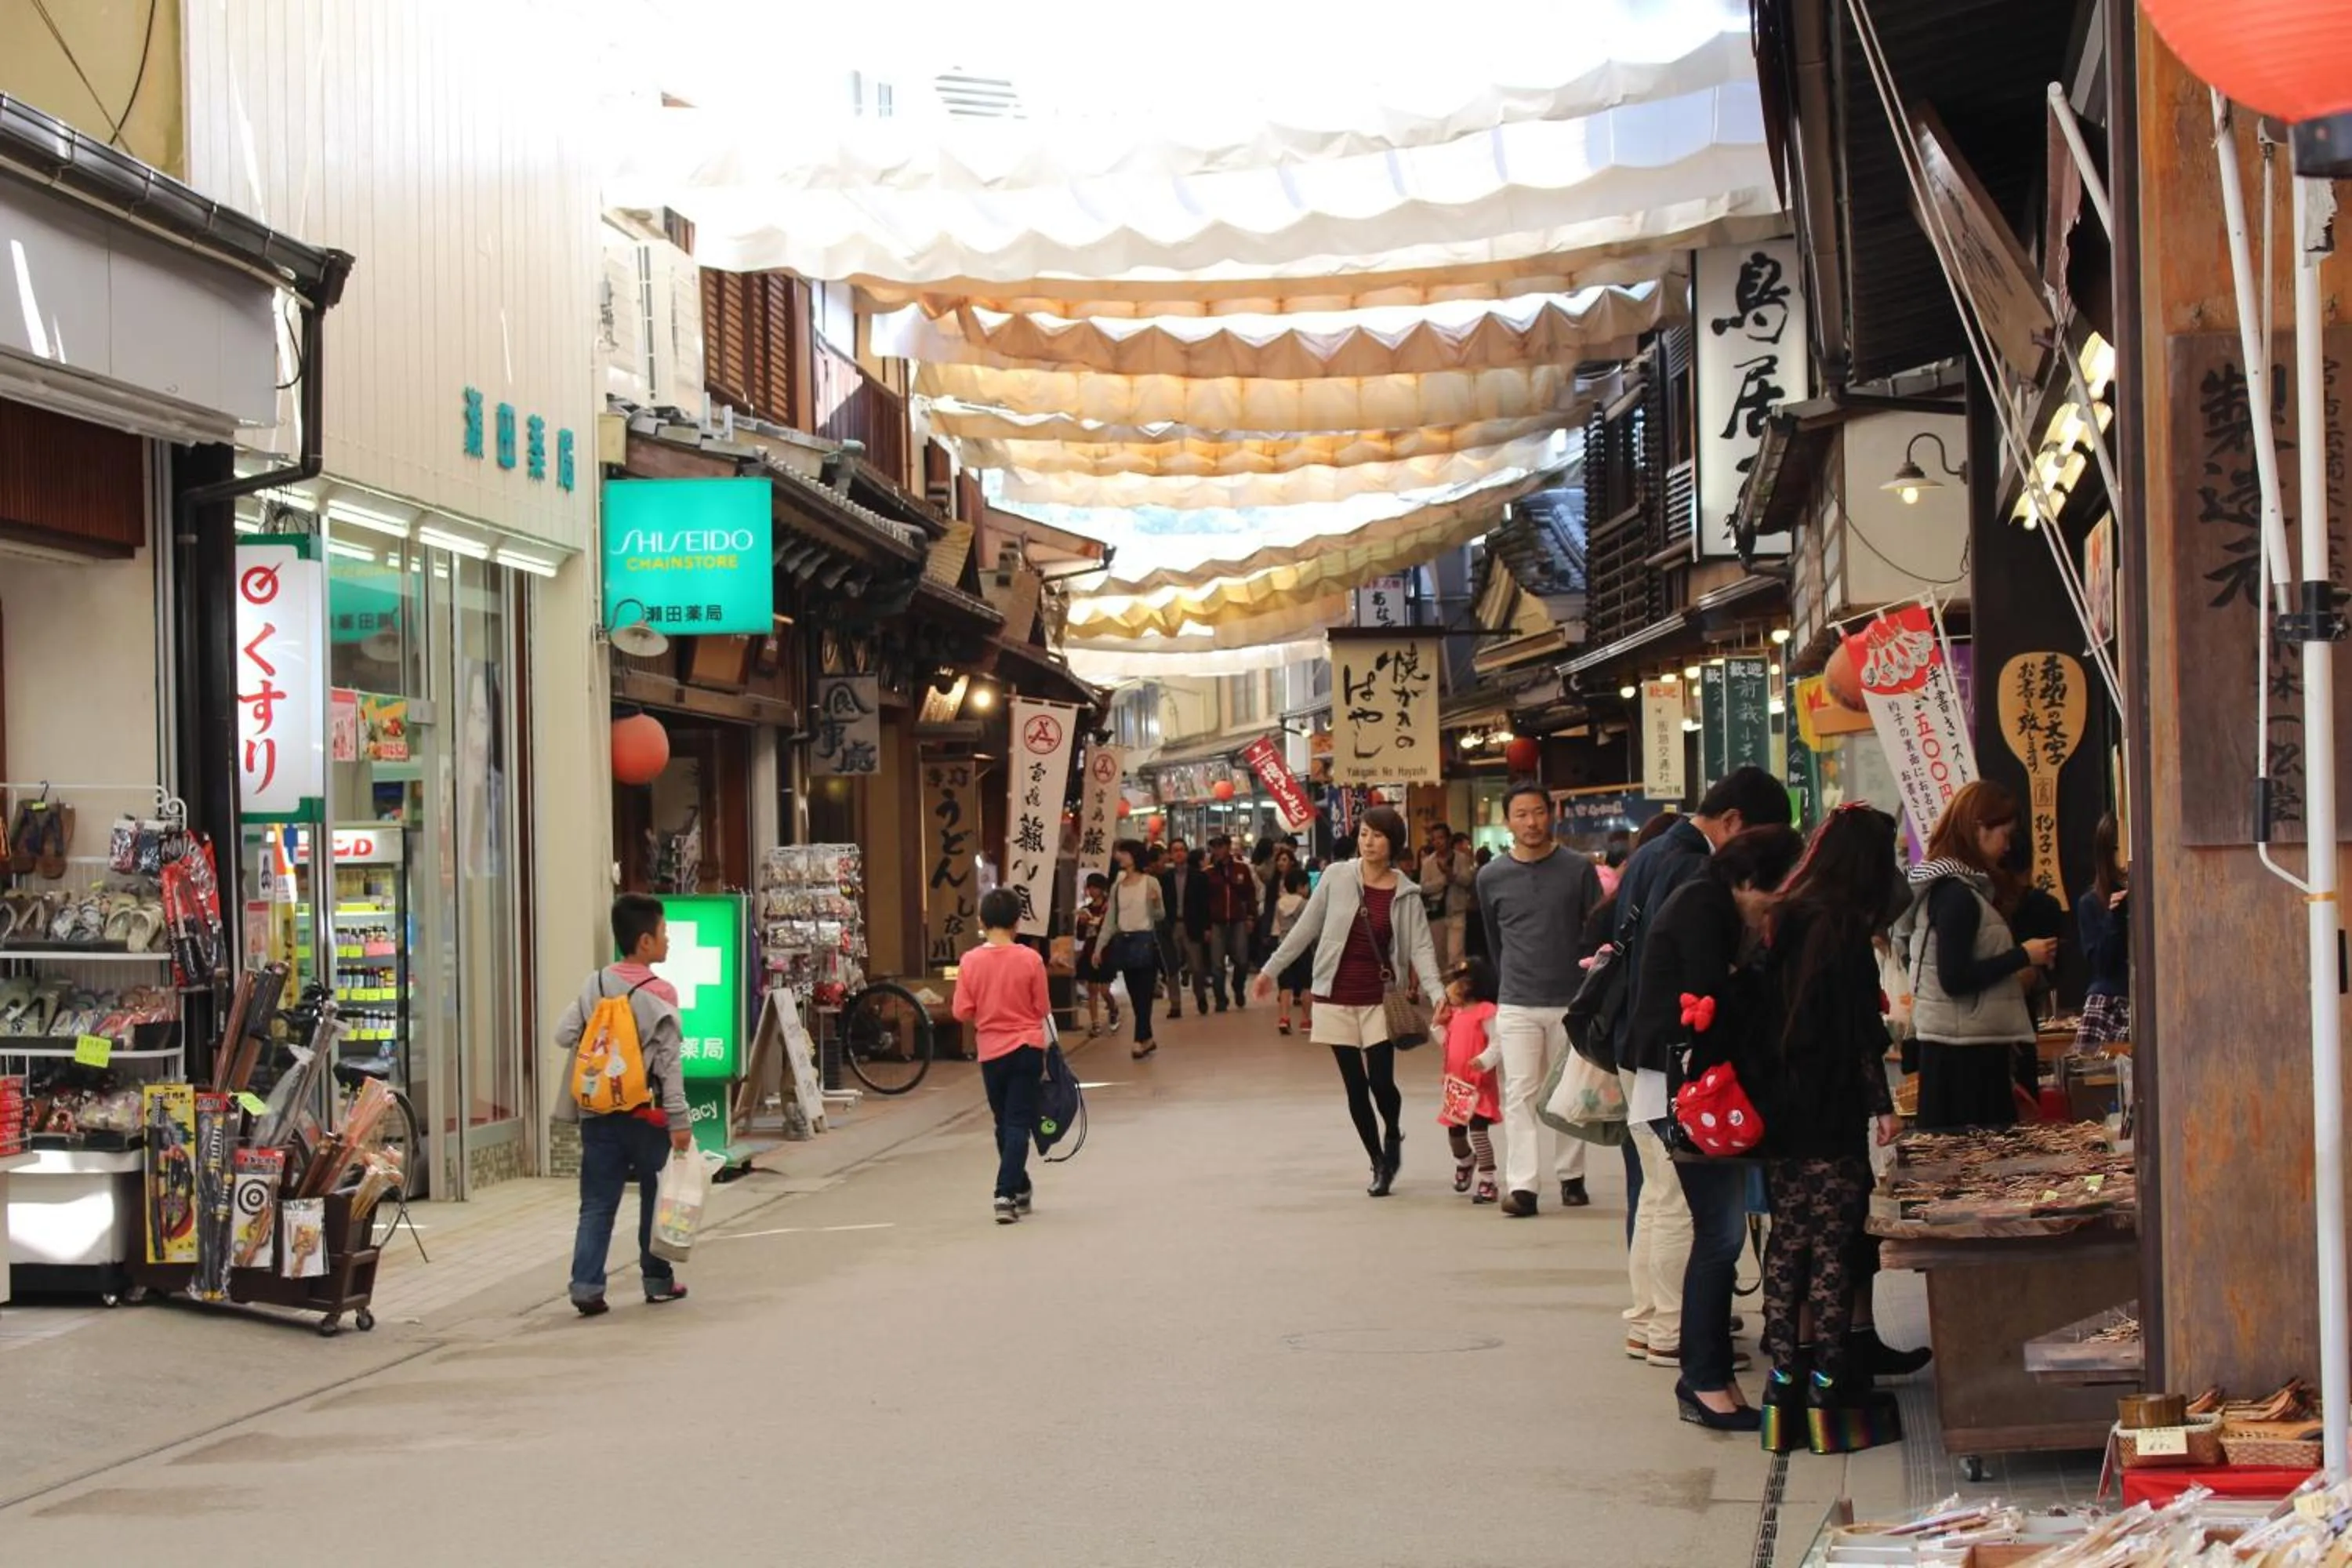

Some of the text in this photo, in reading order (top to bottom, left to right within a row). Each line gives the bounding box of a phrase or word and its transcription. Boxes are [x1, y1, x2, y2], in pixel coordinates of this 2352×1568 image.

[610, 528, 753, 555] SHISEIDO
[626, 554, 739, 571] CHAINSTORE
[237, 622, 287, 794] くすり
[1343, 665, 1383, 758] はやし
[2040, 654, 2068, 765] 希望の文字
[930, 788, 974, 888] うどん
[686, 1100, 717, 1123] acy
